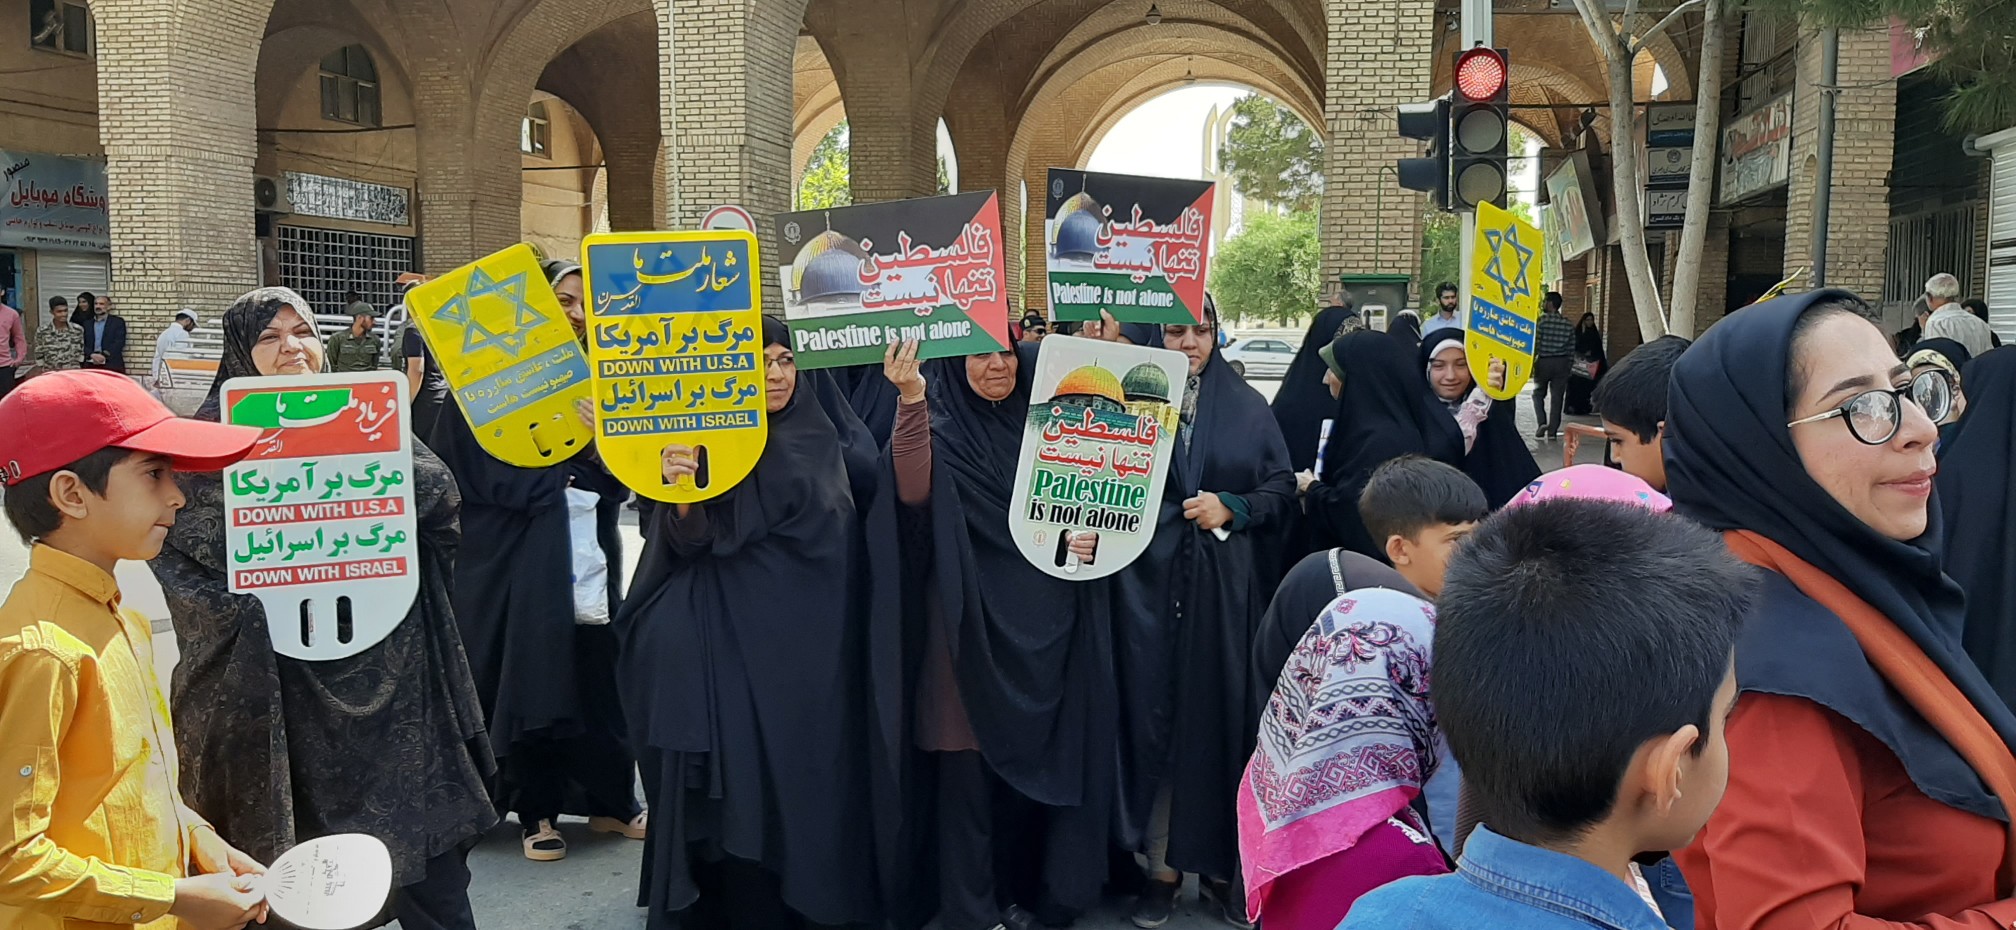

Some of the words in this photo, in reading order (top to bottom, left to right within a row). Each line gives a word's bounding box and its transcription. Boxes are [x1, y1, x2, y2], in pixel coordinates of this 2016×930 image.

[3, 158, 30, 181] منصور
[11, 179, 59, 208] موبایل
[1095, 203, 1204, 248] فلسطین
[633, 248, 644, 268] ما
[637, 245, 712, 284] ملت
[858, 223, 993, 284] فلسطین
[1092, 246, 1155, 283] نیست
[1160, 244, 1200, 283] تنها
[696, 250, 740, 292] شعار
[860, 274, 941, 316] نیست
[944, 268, 996, 310] تنها
[1052, 282, 1101, 304] Palestine
[1103, 286, 1114, 304] is
[1116, 288, 1137, 306] not
[1139, 289, 1174, 307] alone
[1473, 300, 1479, 314] با
[1479, 306, 1498, 320] مبارزه
[1499, 314, 1515, 326] عاشق
[594, 316, 675, 356] آمریکا
[675, 326, 699, 354] بر
[703, 317, 755, 351] مرگ
[795, 324, 882, 352] Palestine
[884, 325, 899, 344] is
[900, 322, 927, 343] not
[929, 320, 971, 340] alone
[516, 360, 544, 383] عاشق
[603, 360, 654, 376] DOWN
[659, 357, 701, 373] WITH
[707, 354, 749, 370] U.S.A
[275, 392, 287, 413] ما
[464, 390, 477, 404] با
[478, 376, 513, 399] مبارزه
[601, 378, 682, 412] اسرائیل
[685, 384, 706, 408] بر
[711, 376, 758, 406] مرگ
[278, 388, 359, 429] ملت
[355, 385, 397, 441] فریاد
[606, 418, 654, 434] DOWN
[659, 415, 697, 431] WITH
[701, 413, 753, 428] ISRAEL
[1042, 405, 1159, 447] فلسطین
[1038, 446, 1106, 475] نیست
[1110, 447, 1152, 478] تنها
[229, 461, 319, 503] آمریکا
[318, 471, 343, 500] بر
[347, 460, 404, 496] مرگ
[1032, 469, 1146, 509] Palestine
[238, 506, 295, 524] DOWN
[300, 502, 347, 520] WITH
[351, 499, 399, 516] U.S.A
[1028, 498, 1046, 521] is
[1049, 503, 1083, 526] not
[1085, 508, 1140, 533] alone
[233, 526, 324, 563] اسرائیل
[326, 532, 350, 557] بر
[355, 522, 407, 552] مرگ
[239, 569, 293, 587] DOWN
[297, 565, 340, 582] WITH
[345, 560, 403, 578] ISRAEL
